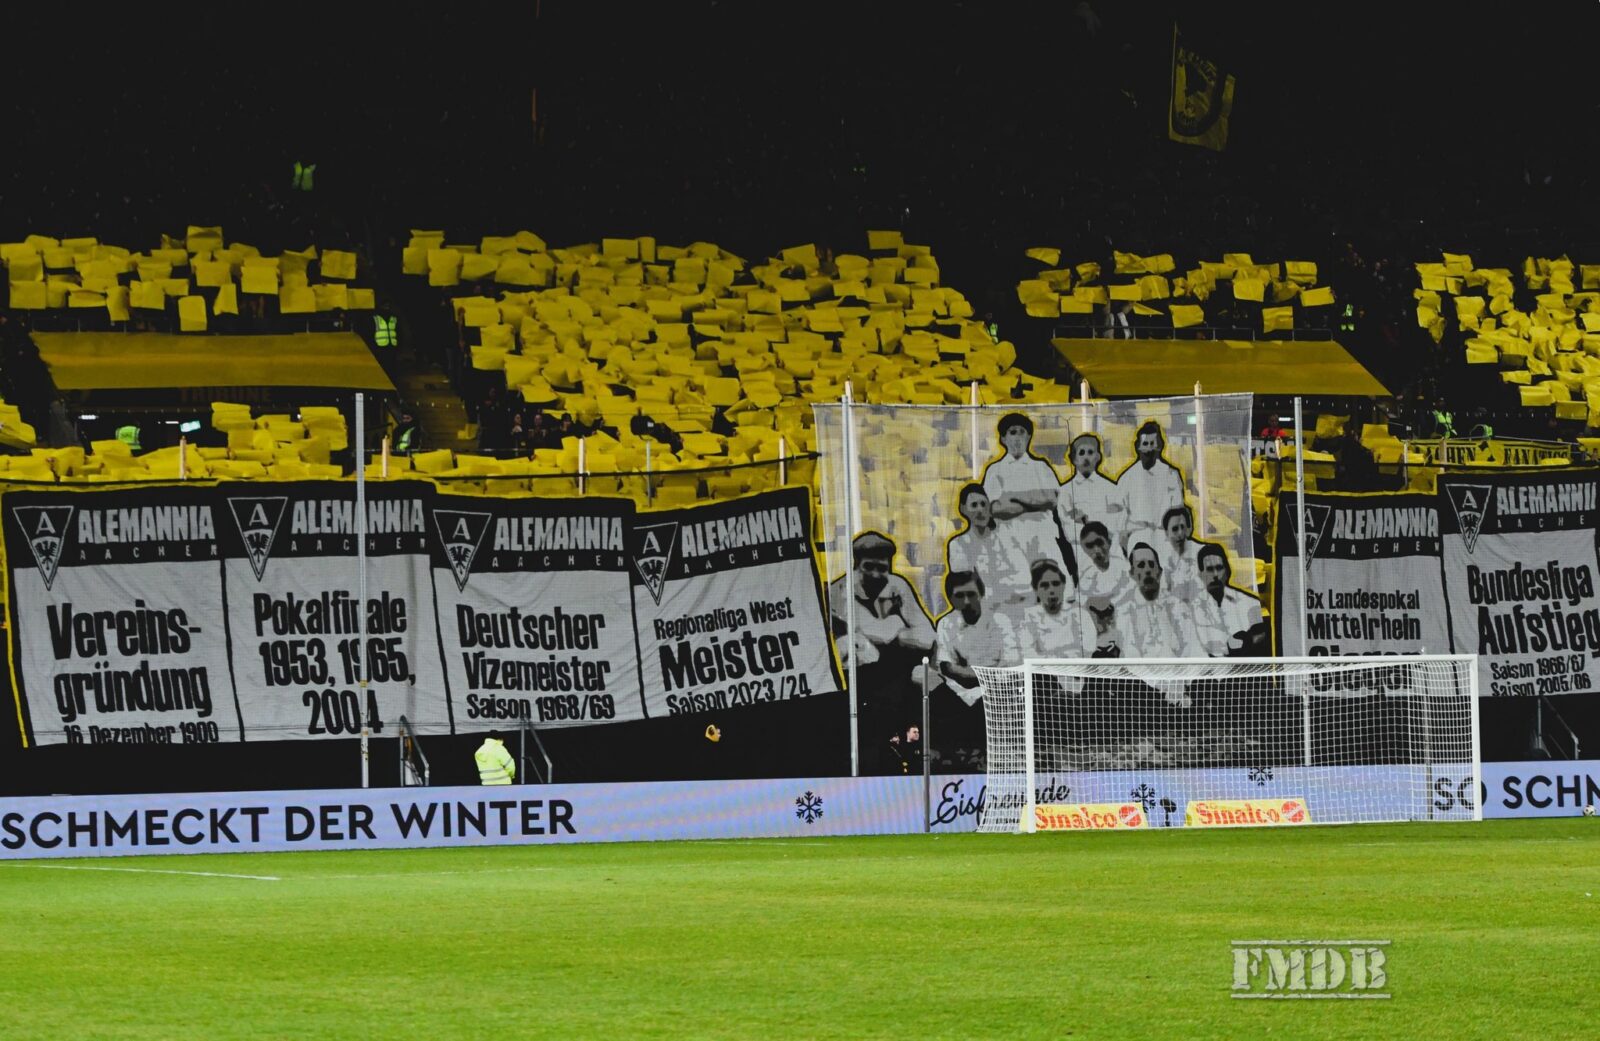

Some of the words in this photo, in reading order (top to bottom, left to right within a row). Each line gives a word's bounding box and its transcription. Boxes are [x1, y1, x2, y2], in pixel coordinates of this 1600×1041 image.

[249, 503, 268, 526] A
[1462, 490, 1478, 509] A
[36, 512, 55, 534] A
[78, 506, 215, 544] ALEMANNIA
[291, 499, 425, 534] ALEMANNIA
[453, 518, 470, 540] A
[1332, 507, 1439, 540] ALEMANNIA
[291, 537, 425, 551] AACHEN
[494, 516, 624, 551] ALEMANNIA
[643, 531, 661, 554] A
[682, 506, 803, 558] ALEMANNIA
[80, 545, 217, 560] AACHEN
[492, 555, 624, 567] AACHEN
[684, 542, 806, 574] AACHEN
[1330, 541, 1440, 554] AACHEN
[1467, 560, 1594, 606] Bundesliga
[1306, 588, 1324, 610] 6x
[1329, 589, 1420, 612] Landespokal
[47, 599, 201, 660] Vereins-
[456, 604, 606, 650] Deutscher
[654, 608, 748, 641] Regionalliga
[750, 597, 794, 624] West
[1307, 613, 1421, 640] Mittelrhein
[1478, 601, 1600, 658] Aufstieg
[259, 638, 335, 687] 1953,
[338, 637, 416, 686] 1965,
[462, 651, 611, 691] Vizemeister
[659, 630, 799, 691] Meister
[1490, 660, 1535, 680] Saison
[1536, 654, 1585, 676] 1966/67
[54, 660, 212, 723] gründung
[1491, 681, 1536, 696] Saison
[1536, 673, 1592, 696] 2005/06
[303, 689, 384, 735] 2004
[467, 694, 531, 719] Saison
[536, 694, 615, 722] 1968/69
[666, 689, 728, 715] Saison
[88, 722, 176, 744] Dezember
[179, 721, 219, 743] 1900
[1434, 777, 1487, 811] SO
[1, 806, 269, 849] SCHMECKT
[285, 804, 377, 842] DER
[390, 799, 577, 840] WINTER
[1035, 804, 1118, 830] Sinalco
[1195, 801, 1280, 826] Sinalco
